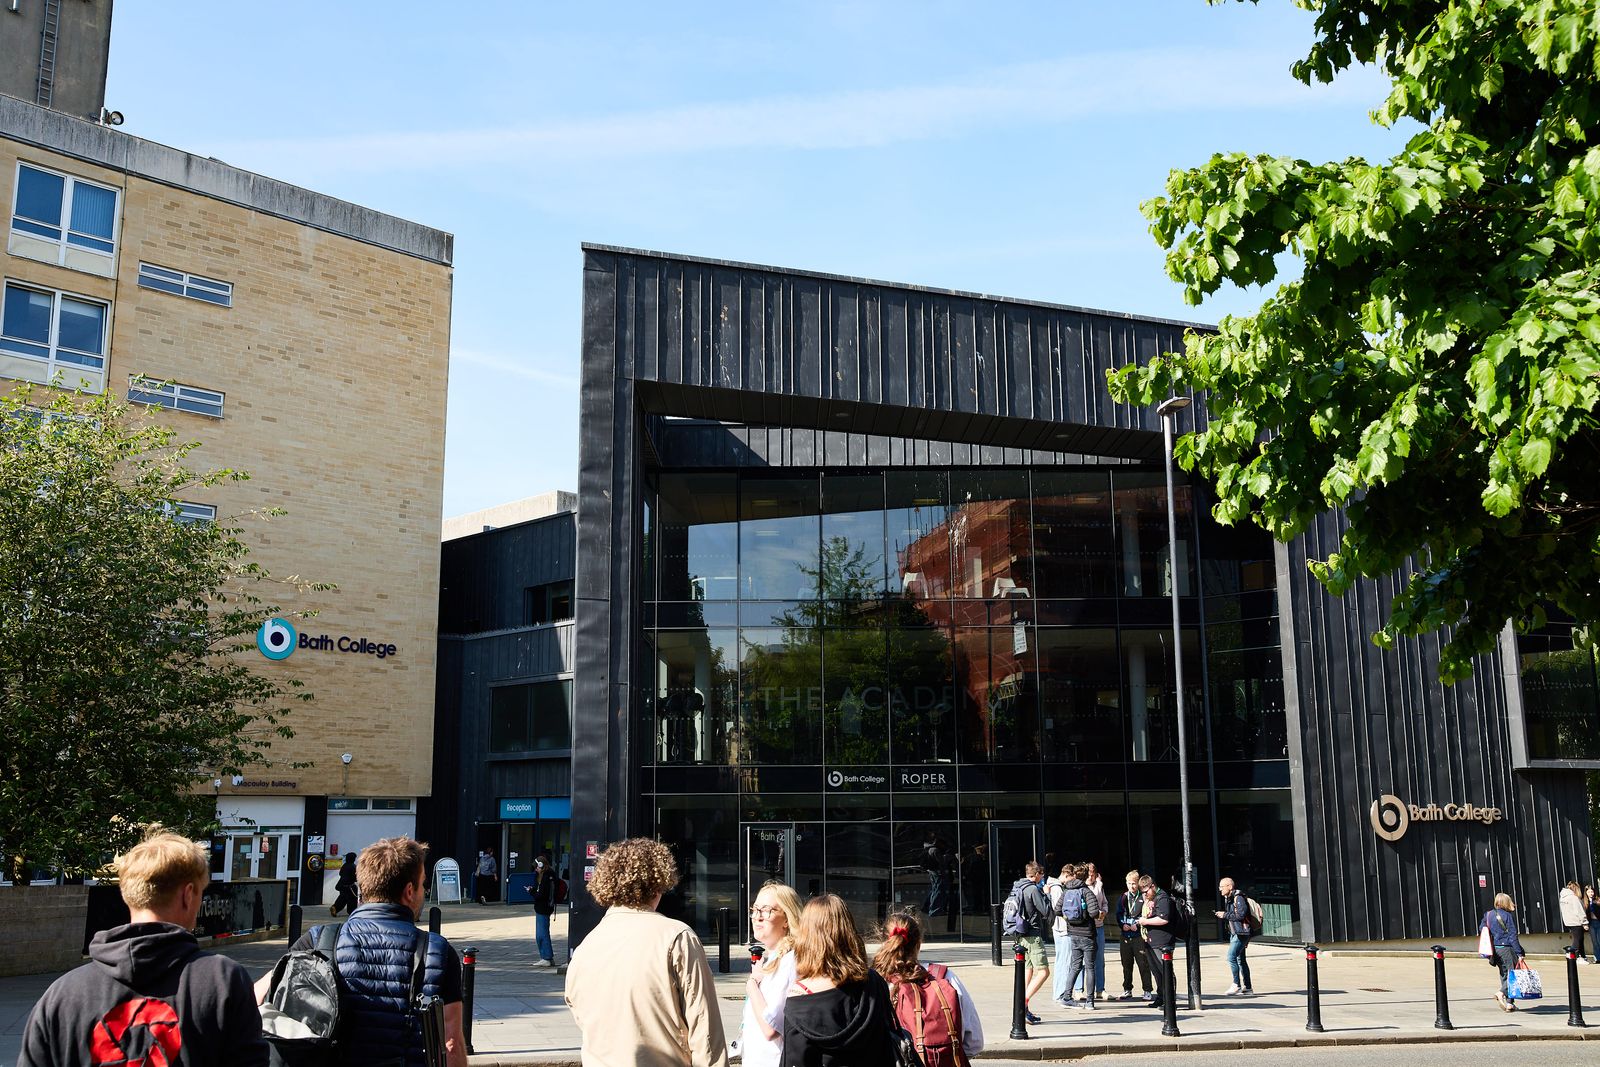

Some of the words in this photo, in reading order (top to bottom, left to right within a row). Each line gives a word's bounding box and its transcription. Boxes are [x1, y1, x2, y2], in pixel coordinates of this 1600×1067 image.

[298, 633, 334, 651] Bath
[337, 636, 397, 659] College
[758, 686, 822, 711] THE
[237, 780, 269, 788] Macaulay
[271, 780, 297, 789] Building
[844, 775, 859, 783] Bath
[860, 775, 886, 785] College
[901, 773, 947, 785] ROPER
[506, 803, 532, 813] Reception
[1409, 803, 1444, 821] Bath
[1444, 803, 1502, 825] College
[760, 832, 775, 841] Bath
